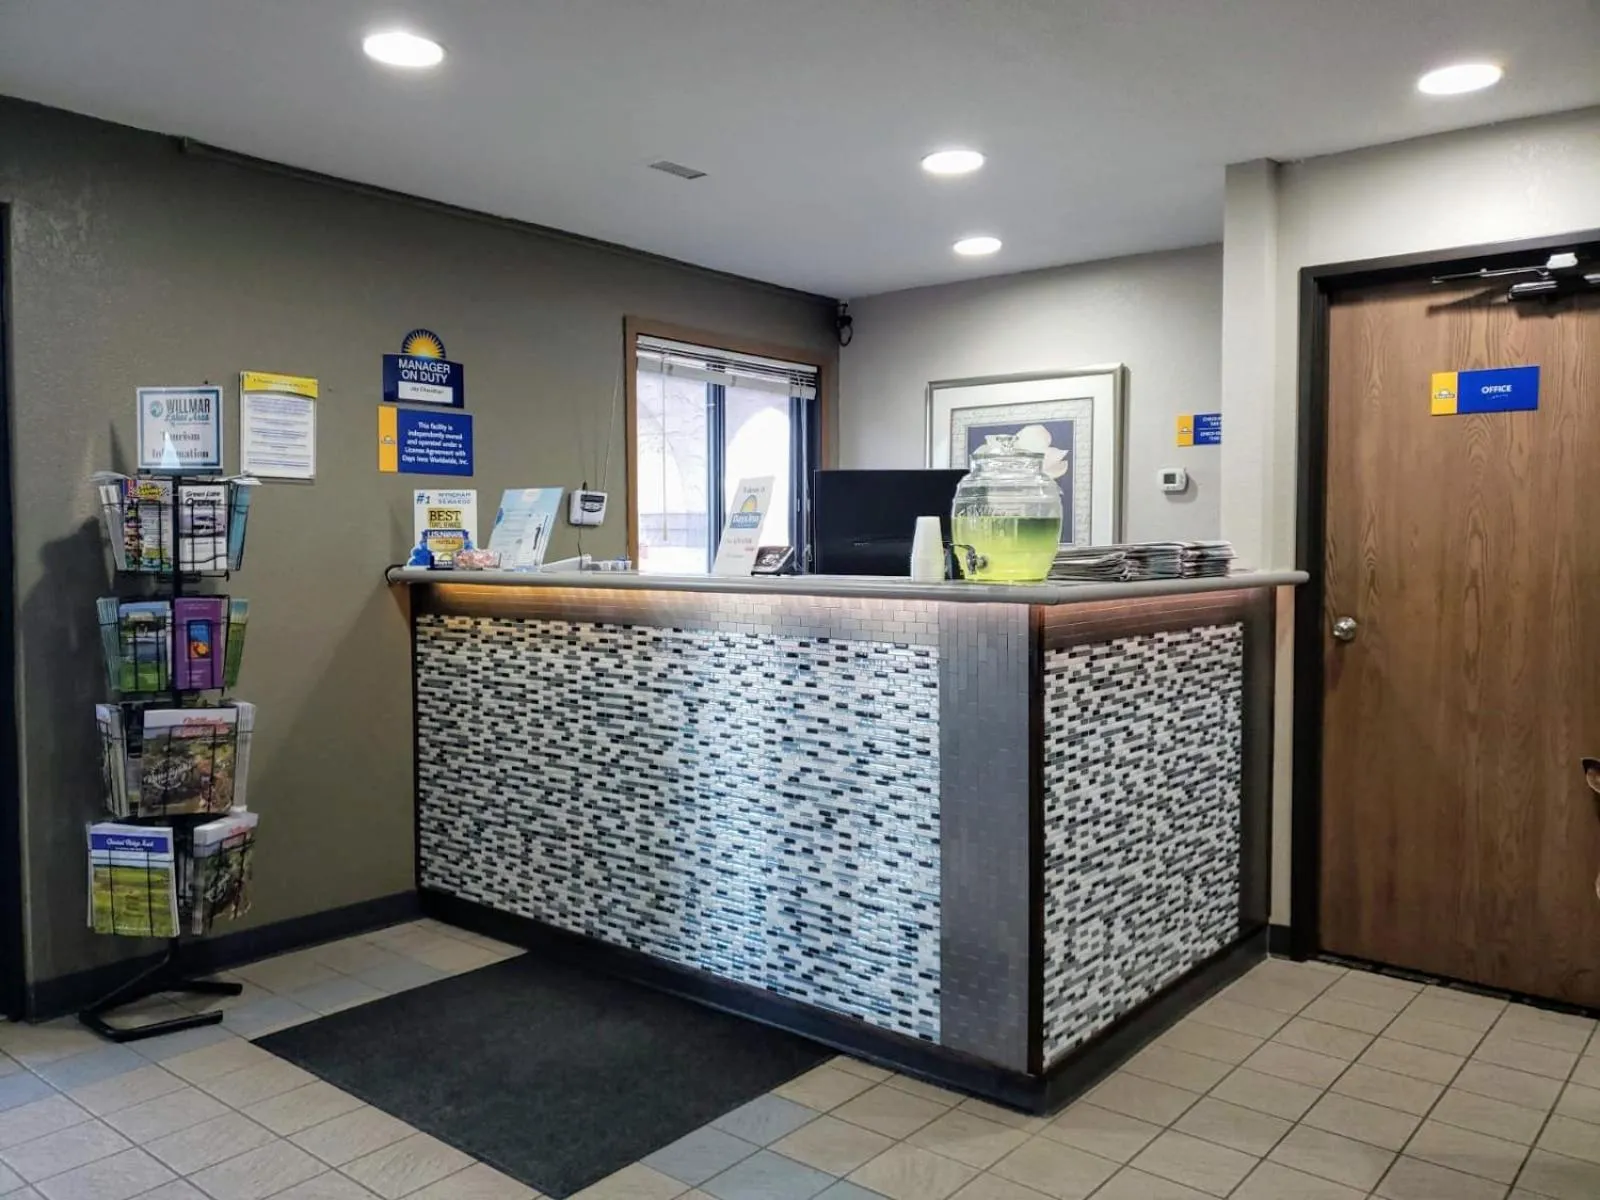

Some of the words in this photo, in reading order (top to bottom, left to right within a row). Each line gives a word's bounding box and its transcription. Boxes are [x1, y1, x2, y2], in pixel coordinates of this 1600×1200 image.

[398, 358, 450, 374] MANAGER
[401, 369, 418, 380] ON
[420, 371, 448, 383] DUTY
[1481, 385, 1512, 394] OFFICE
[165, 398, 210, 413] WILLMAR
[418, 421, 430, 429] This
[431, 423, 447, 432] facility
[408, 429, 445, 440] independently
[404, 446, 425, 454] License
[426, 447, 454, 456] Agreement
[402, 454, 416, 463] Days
[430, 456, 457, 465] Worldwide,
[417, 493, 430, 504] #1
[429, 510, 462, 521] BEST
